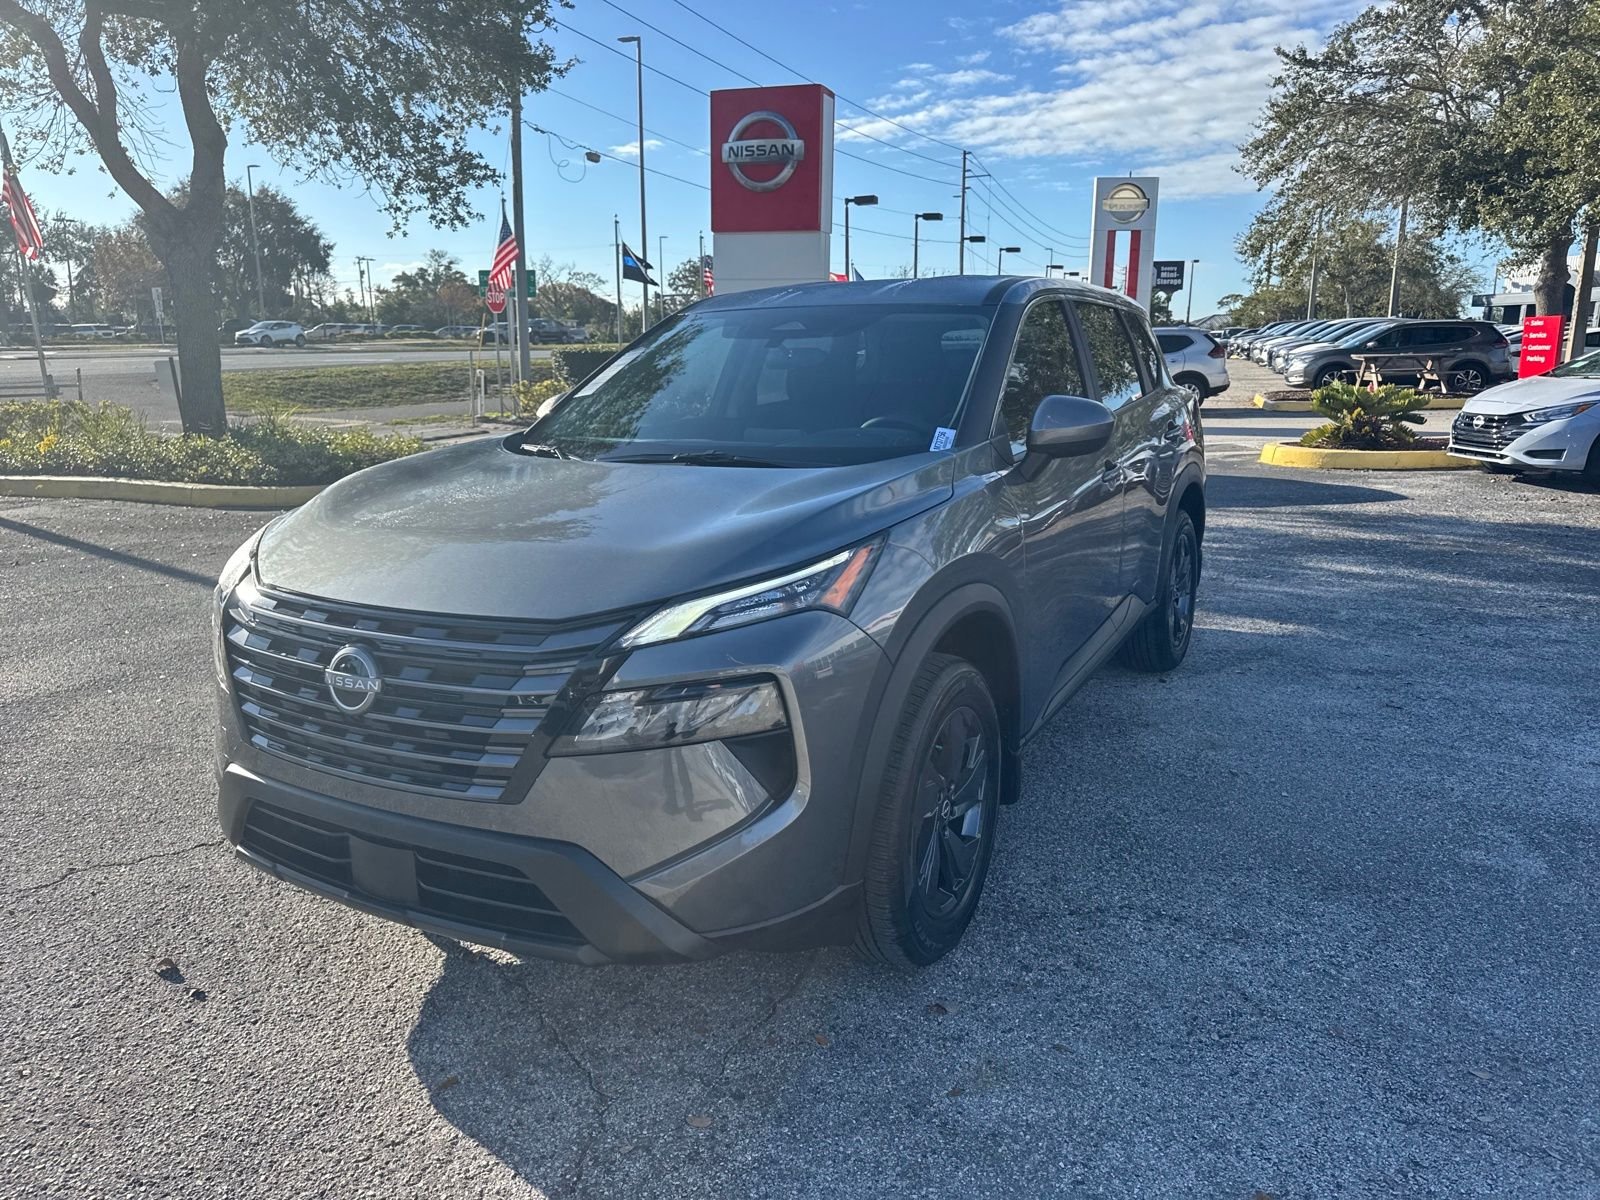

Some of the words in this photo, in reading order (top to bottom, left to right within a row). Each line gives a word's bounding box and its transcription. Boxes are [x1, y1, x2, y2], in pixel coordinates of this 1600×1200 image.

[728, 143, 795, 158] NISSAN
[1156, 278, 1182, 286] Storage
[487, 292, 505, 304] STOP
[1526, 355, 1546, 363] Parking
[325, 671, 379, 690] NISSAN
